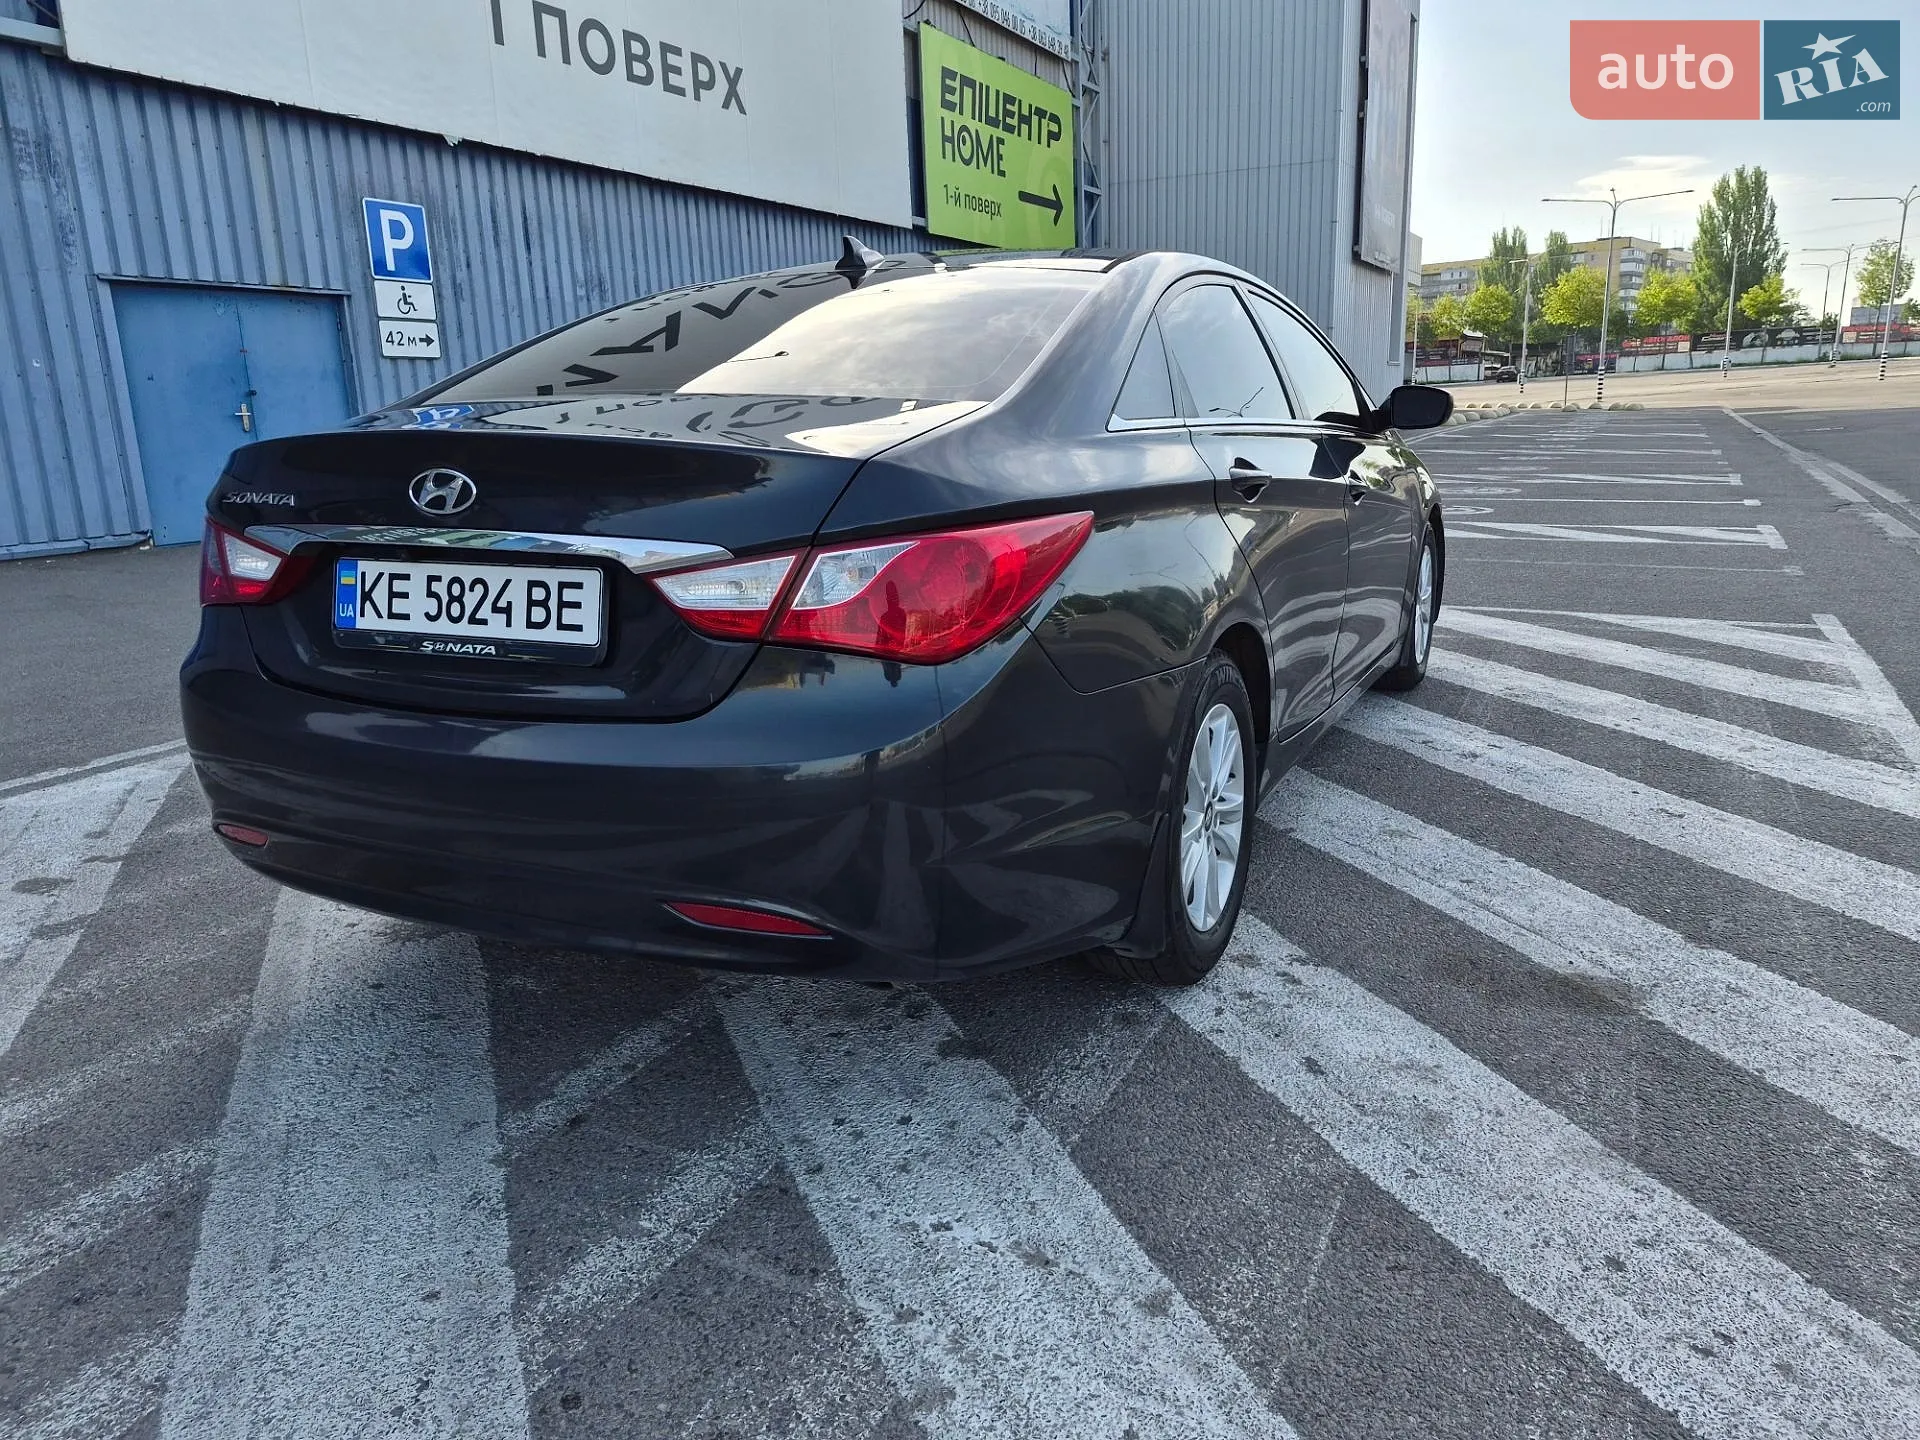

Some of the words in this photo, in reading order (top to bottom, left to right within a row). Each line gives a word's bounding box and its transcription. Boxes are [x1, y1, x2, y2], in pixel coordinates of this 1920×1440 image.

[532, 0, 747, 115] ПОВЕРХ
[940, 65, 1062, 149] ЕПІЦЕНТР
[940, 116, 1006, 178] HOME
[943, 184, 961, 208] 1-й
[964, 194, 1002, 220] поверх
[380, 209, 414, 271] P
[222, 492, 295, 506] SONATA
[340, 603, 354, 617] UA
[360, 571, 411, 621] KE
[425, 575, 512, 627] 5824
[526, 580, 584, 632] BE
